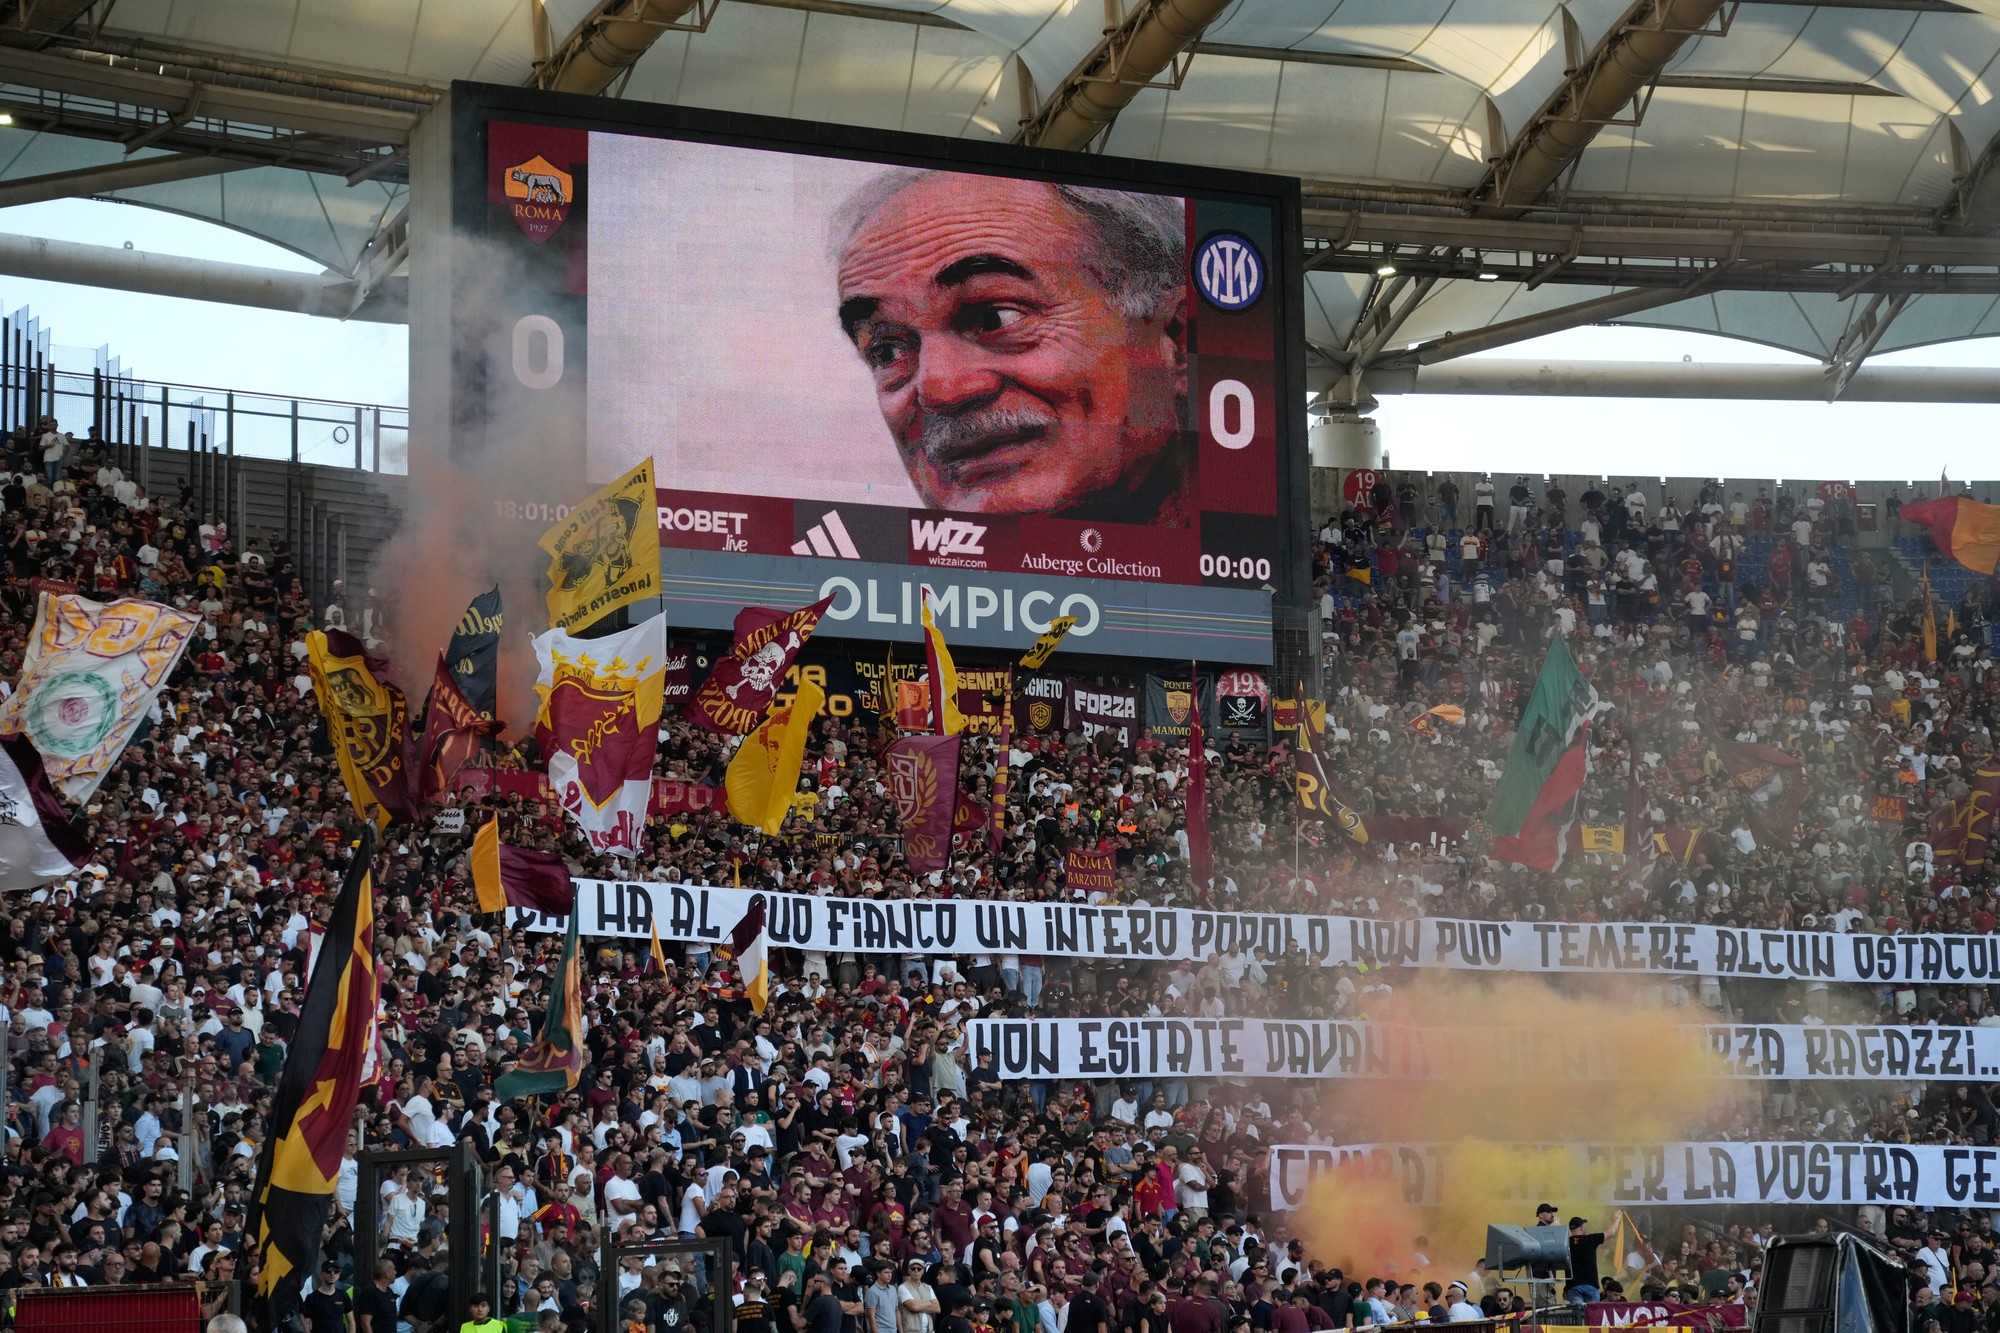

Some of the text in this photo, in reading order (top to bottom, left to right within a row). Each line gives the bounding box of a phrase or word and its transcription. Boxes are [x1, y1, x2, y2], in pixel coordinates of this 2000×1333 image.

[514, 203, 562, 221] ROMA
[529, 223, 548, 233] 1927
[511, 315, 565, 388] 0
[1208, 379, 1255, 450] 0
[1356, 472, 1375, 490] 19
[494, 500, 577, 523] 18:01:0
[722, 534, 748, 552] .live
[928, 556, 987, 568] wizzair.com
[1020, 553, 1161, 578] Auberge Collection
[1200, 554, 1271, 580] 00:00
[819, 576, 1100, 637] OLIMPICO
[855, 661, 915, 680] POLPTTA
[1163, 680, 1192, 690] PONTE
[1229, 672, 1251, 693] 19
[1074, 689, 1136, 719] FORZA
[1877, 796, 1900, 810] MAI
[1871, 807, 1902, 821] SOLA
[1069, 852, 1112, 870] ROMA
[1067, 871, 1113, 887] BARZOTTA
[597, 883, 653, 934] HA
[671, 888, 720, 938] AL
[749, 893, 812, 944] UO
[975, 904, 1028, 949] UN
[1533, 924, 1699, 971] TEMERE
[1716, 929, 1836, 978] ALCUN
[1683, 1146, 1736, 1200] LA
[1755, 1143, 1919, 1203] VOSTRA
[1943, 1149, 2000, 1202] GE
